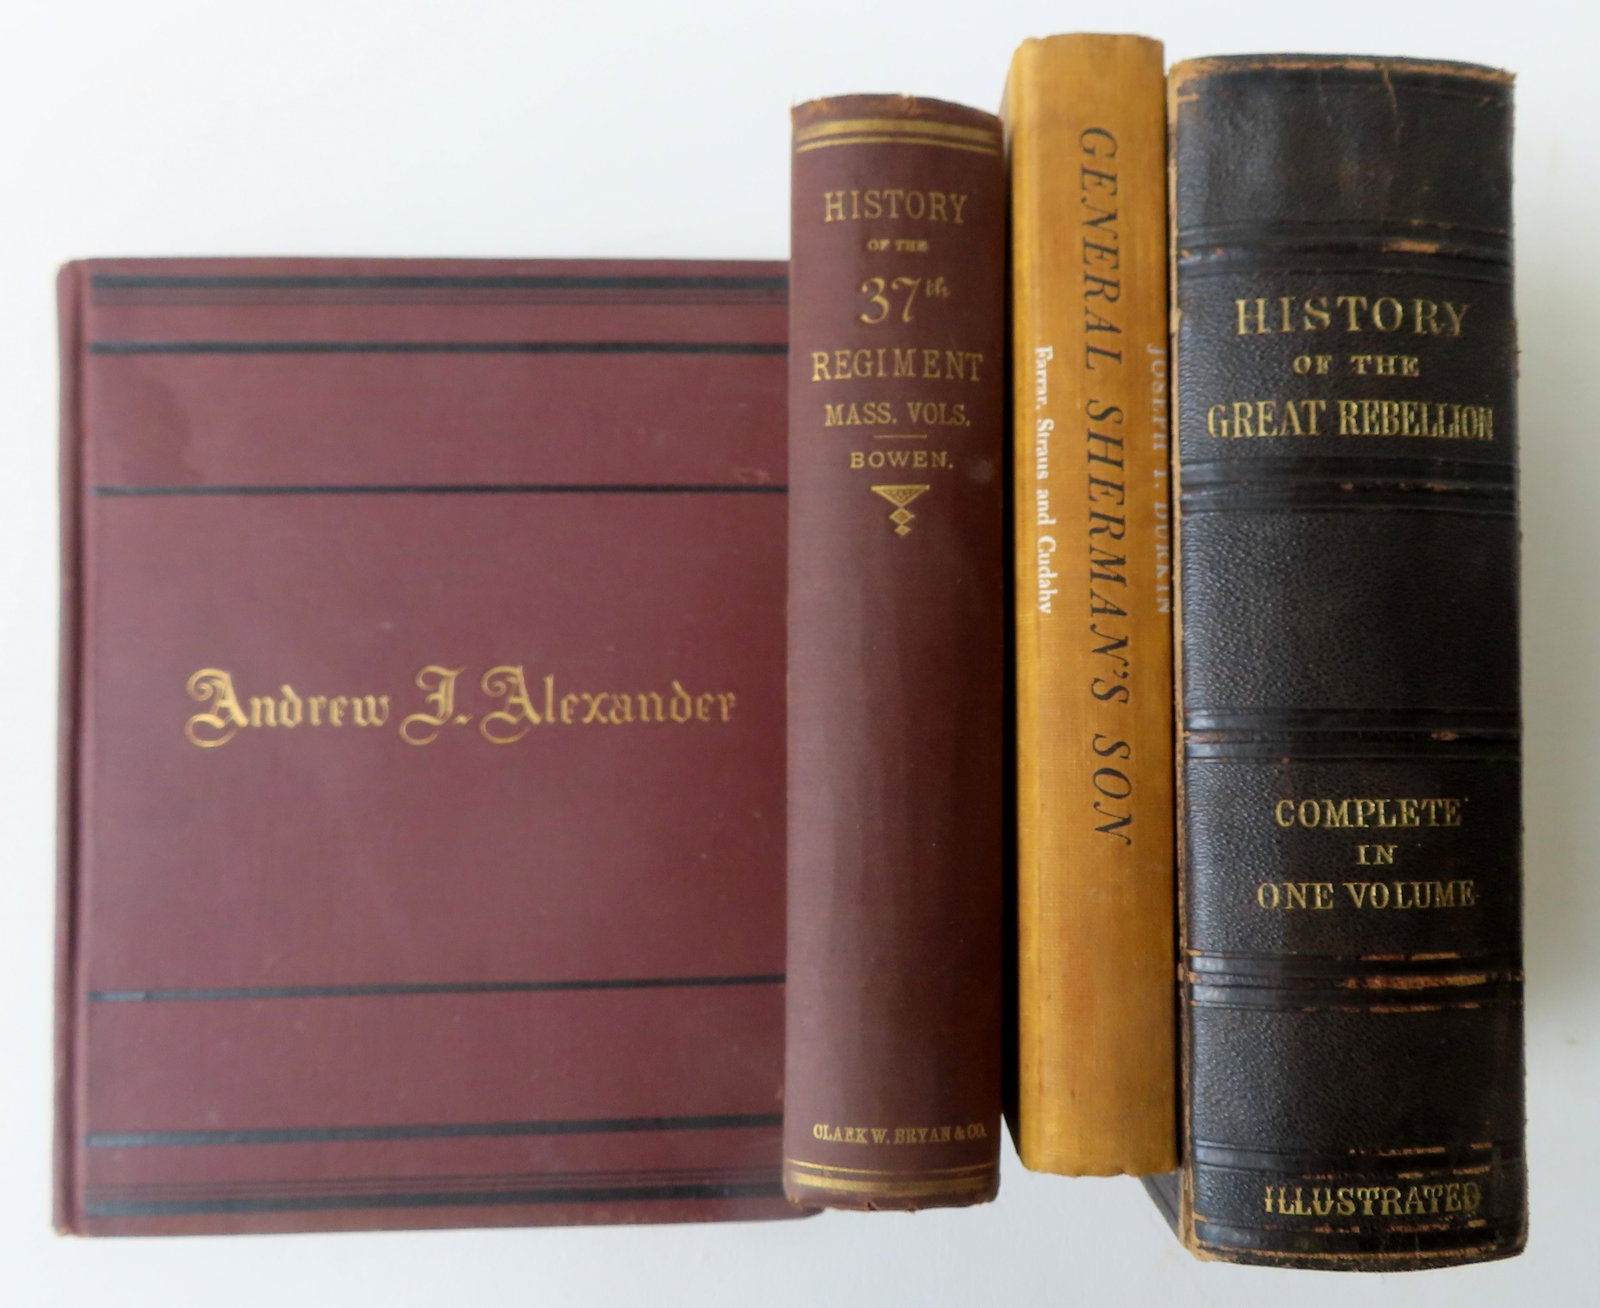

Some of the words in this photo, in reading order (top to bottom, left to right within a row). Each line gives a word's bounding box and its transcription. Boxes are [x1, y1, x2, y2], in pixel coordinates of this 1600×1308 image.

[822, 188, 968, 225] HISTORY
[867, 239, 891, 252] OF
[894, 239, 929, 253] THE
[1078, 126, 1123, 370] GENERAL
[860, 276, 951, 324] 37th
[1234, 296, 1470, 337] HISTORY
[810, 348, 984, 383] REGIMENT
[1292, 354, 1332, 376] OF
[1350, 354, 1420, 378] THE
[823, 403, 898, 427] MASS.
[907, 402, 971, 427] VOLS.
[1207, 400, 1327, 439] GREAT
[1338, 400, 1494, 441] REBELLION
[850, 450, 954, 470] BOWEN.
[1035, 418, 1055, 480] Straus
[1036, 489, 1057, 526] and
[1036, 535, 1059, 615] Cudahy
[185, 667, 391, 749] Andrew
[480, 664, 737, 745] Alexander
[1091, 733, 1134, 846] SON
[1274, 798, 1463, 829] COMPLETE
[1355, 844, 1398, 866] IN
[1256, 882, 1334, 910] ONE
[1342, 880, 1477, 910] VOLUME
[813, 1122, 869, 1145] CLARK
[871, 1128, 891, 1145] W.
[894, 1126, 951, 1145] BRYAN
[953, 1125, 966, 1141] &
[1265, 1182, 1481, 1217] ILLUSTRATED
